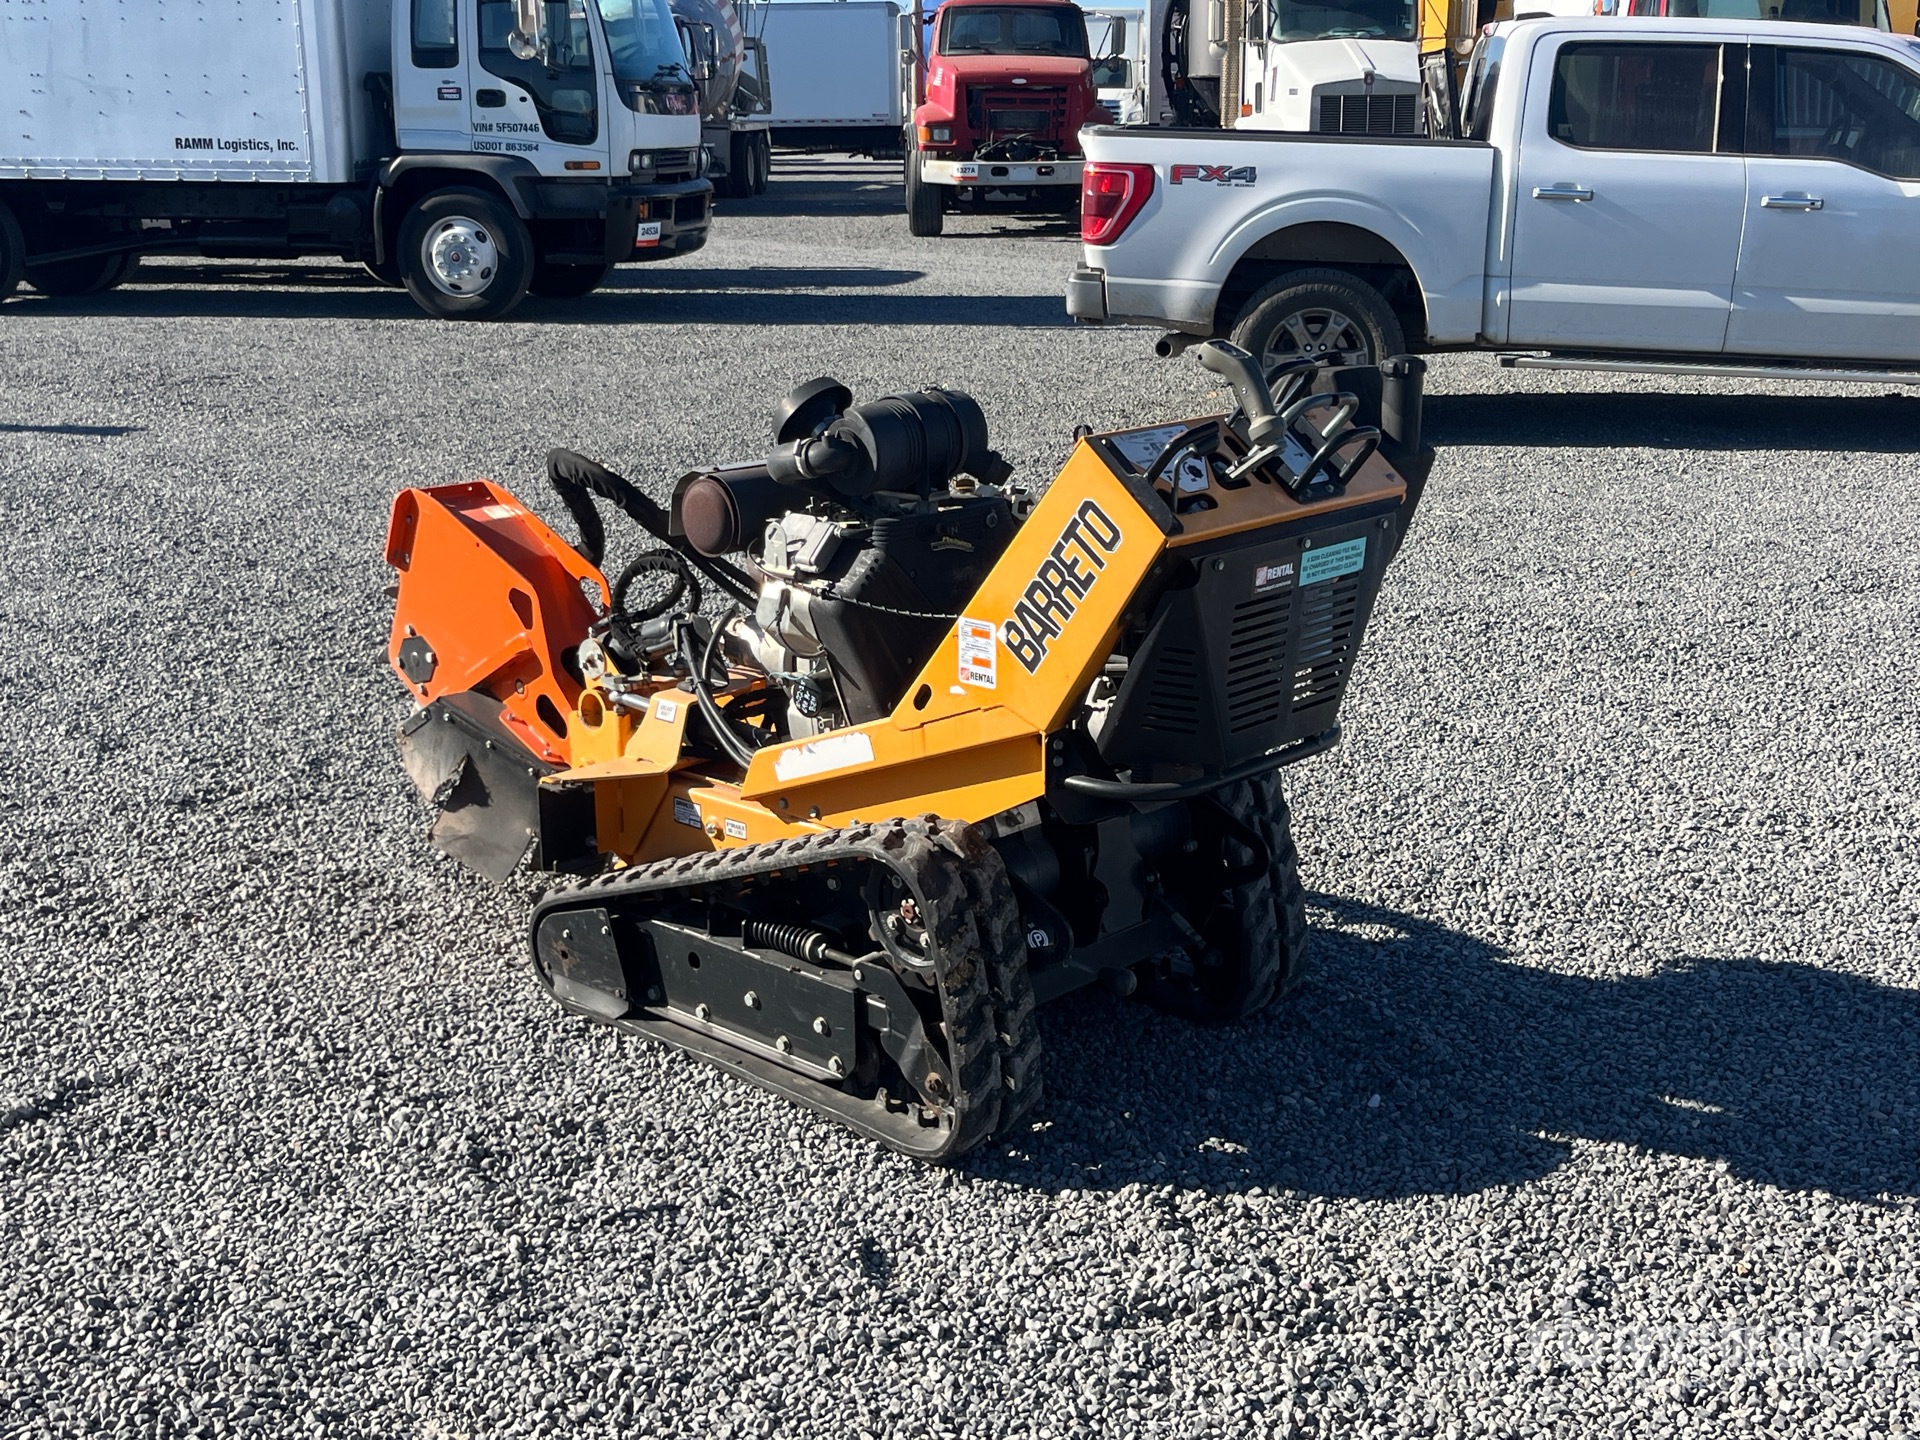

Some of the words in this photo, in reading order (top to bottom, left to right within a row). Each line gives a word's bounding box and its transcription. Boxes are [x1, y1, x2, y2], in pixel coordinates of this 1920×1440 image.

[472, 122, 494, 133] VIN#
[495, 123, 540, 133] 5F507446
[175, 137, 214, 150] RAMM
[217, 138, 274, 153] Logistics,
[277, 138, 299, 151] Inc.
[473, 141, 504, 151] USDOT
[505, 142, 540, 152] 863564
[956, 166, 976, 174] 1327A
[1169, 163, 1258, 185] FX4
[1266, 562, 1295, 581] RENTAL
[1003, 498, 1123, 676] BARRETO
[970, 671, 995, 685] RENTAL
